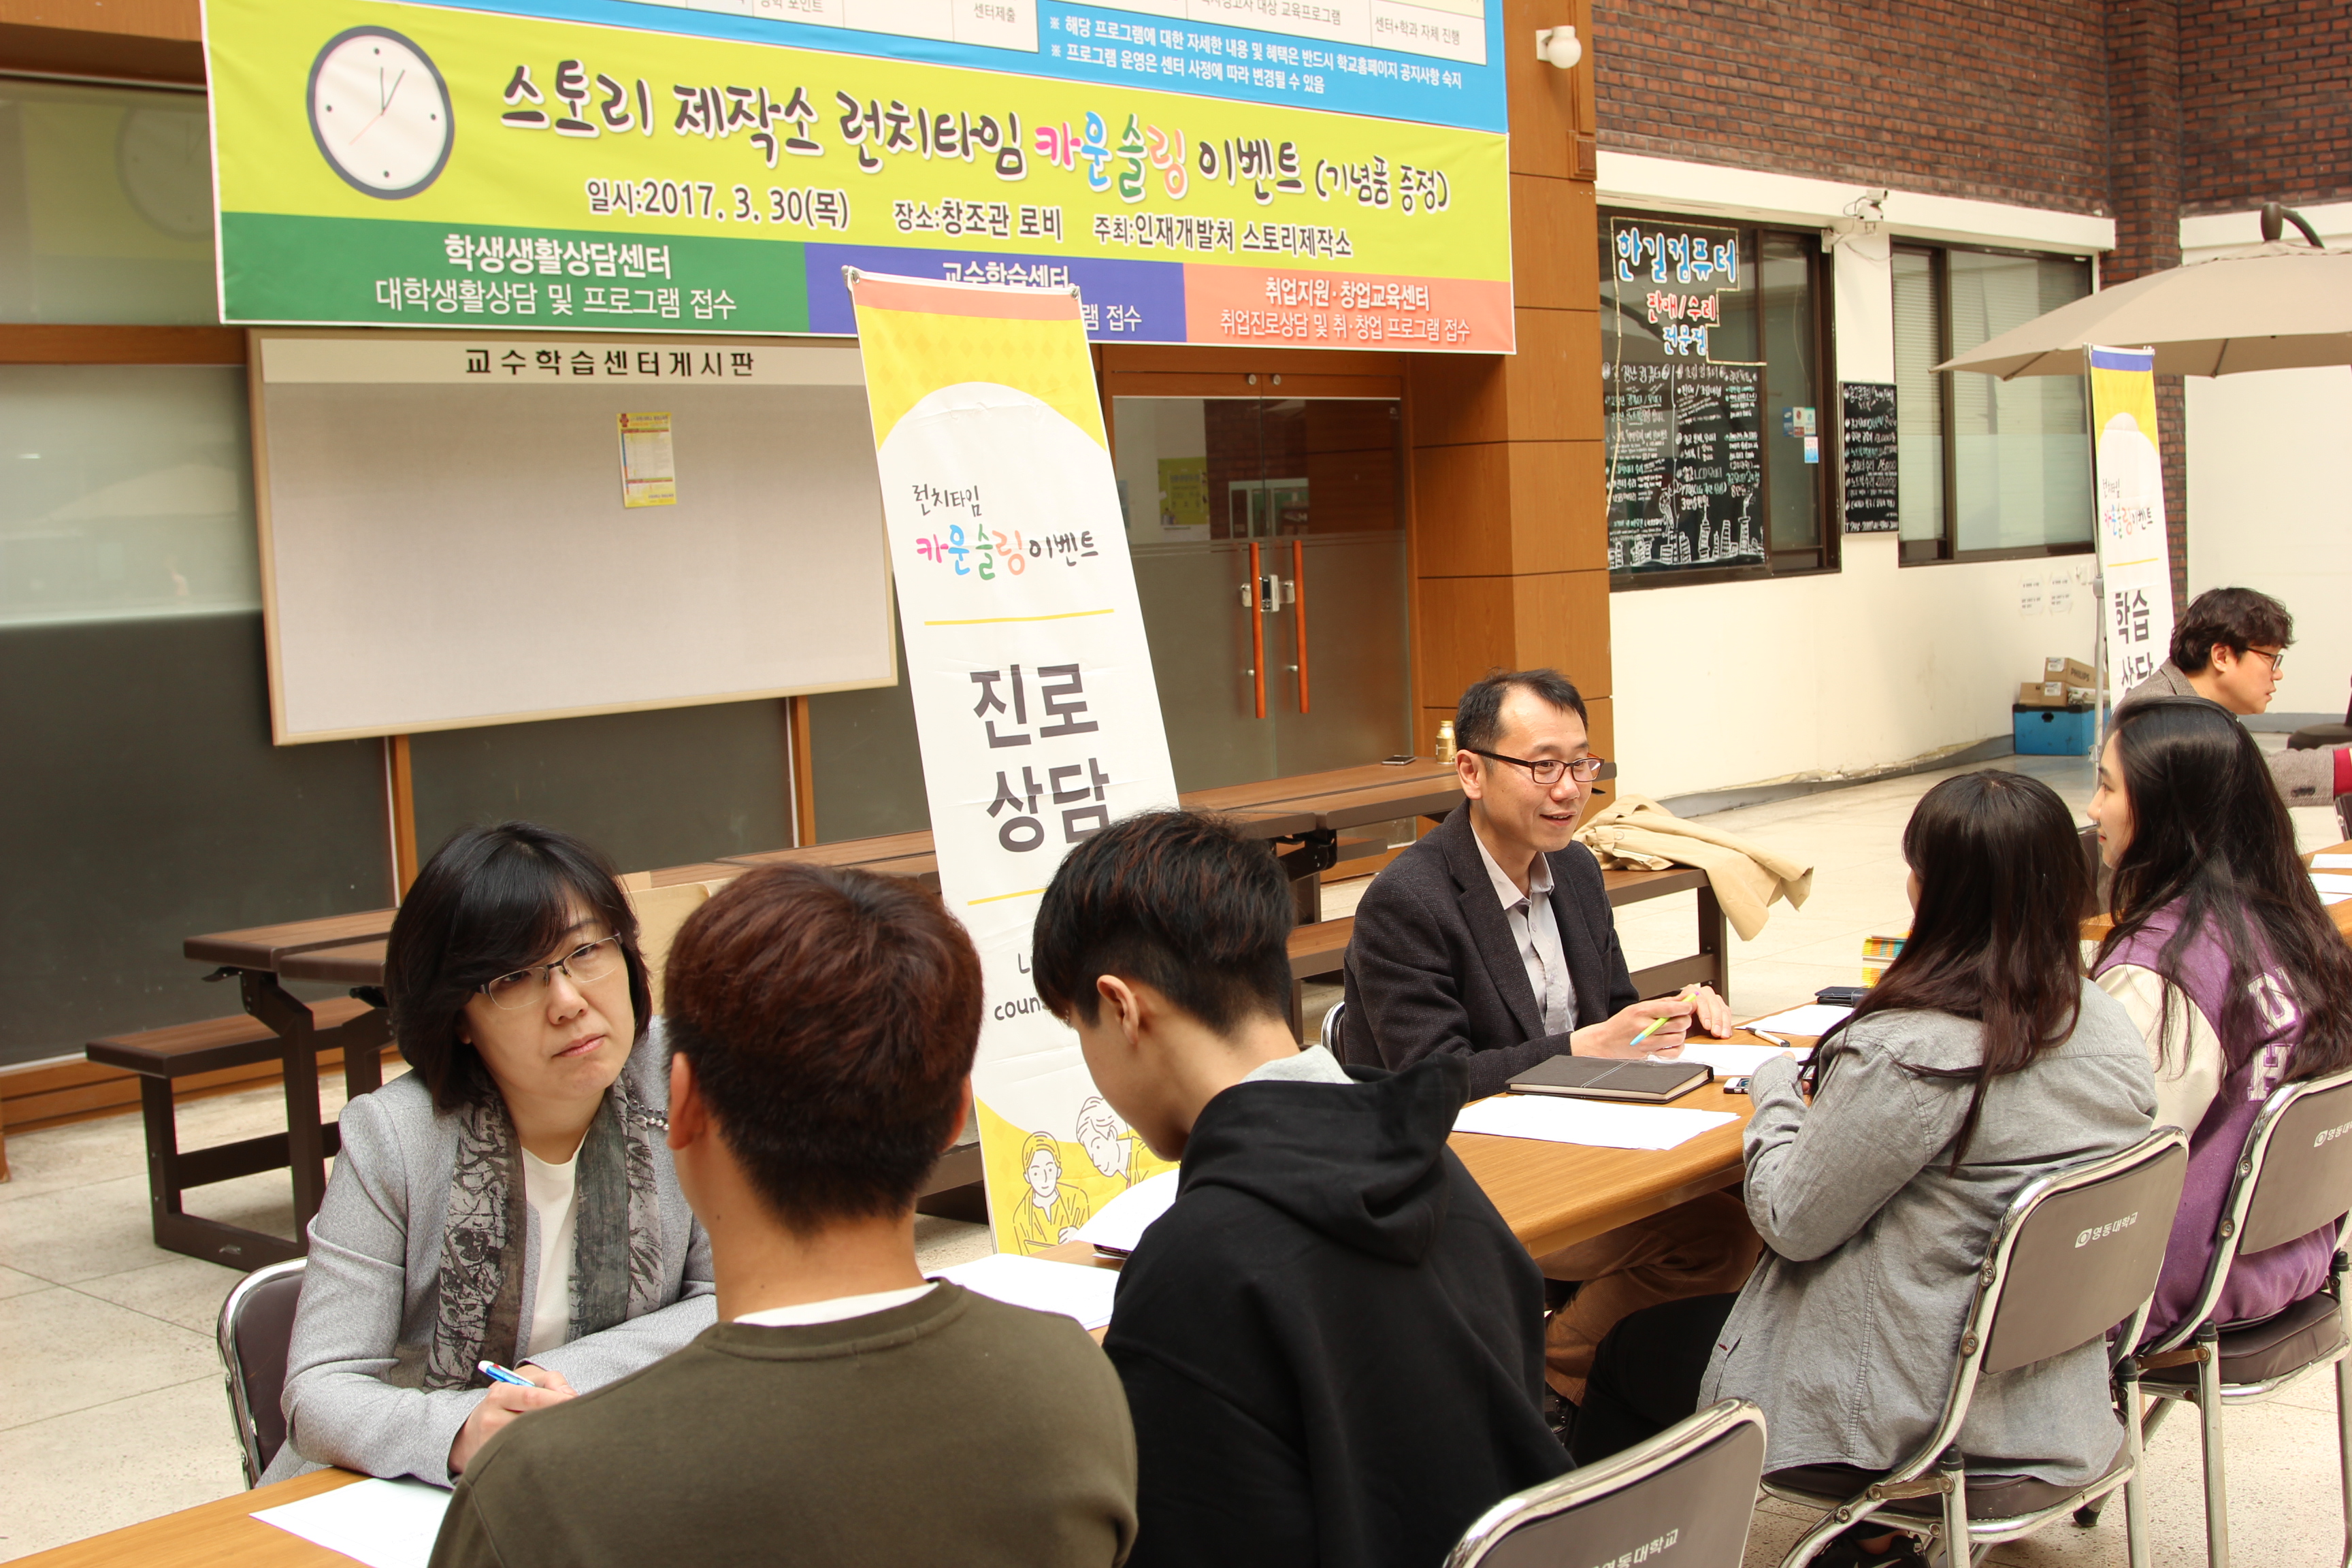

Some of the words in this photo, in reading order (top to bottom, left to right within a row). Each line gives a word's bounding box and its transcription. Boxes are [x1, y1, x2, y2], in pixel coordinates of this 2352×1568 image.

[973, 3, 1016, 22] 센터제출
[1257, 0, 1277, 16] 대상
[1281, 2, 1341, 25] 교육프로그램
[1375, 16, 1418, 37] 센터+학과
[1421, 24, 1439, 42] 자체
[1442, 28, 1460, 46] 진행
[1065, 16, 1091, 37] 해당
[1094, 20, 1156, 46] 프로그램에
[1160, 29, 1183, 50] 대한
[1187, 33, 1222, 55] 자세한
[1226, 38, 1248, 59] 내용
[1252, 42, 1263, 61] 및
[1266, 44, 1298, 65] 혜택은
[1302, 50, 1334, 70] 반드시
[1337, 53, 1398, 80] 학교홈페이지
[1400, 63, 1440, 86] 공지사항
[1441, 69, 1462, 89] 숙지
[1066, 44, 1117, 68] 프로그램
[1120, 50, 1158, 73] 운영은
[1160, 55, 1185, 77] 센터
[1188, 59, 1223, 81] 사정에
[1227, 65, 1250, 84] 따라
[1253, 67, 1286, 89] 변경될
[1288, 74, 1301, 91] 수
[1303, 75, 1324, 94] 있음
[502, 59, 651, 135] 스토리
[674, 84, 821, 167] 제작소
[836, 91, 1026, 179] 런치타임
[1034, 112, 1186, 200] 카운슬링
[1199, 138, 1304, 203] 이벤트
[1316, 154, 1390, 206] (기념품
[1399, 163, 1449, 212] 증정)
[770, 189, 849, 229] 30(목)
[894, 199, 1010, 237] 장소:창조관
[1019, 207, 1062, 241] 로비
[1094, 214, 1234, 252] 주최:인재개발처
[1242, 223, 1352, 258] 스토리제작소
[444, 233, 671, 280] 학생생활상담센터
[1616, 227, 1736, 284] 한길컴퓨터
[376, 277, 538, 315] 대학생활상담
[548, 284, 573, 316] 및
[583, 287, 681, 318] 프로그램
[690, 289, 737, 321] 접수
[1647, 290, 1716, 324] 판매/수리
[1106, 304, 1142, 332] 접수
[1220, 309, 1308, 338] 취업진로상담
[1313, 313, 1328, 338] 및
[1388, 316, 1440, 342] 프로그램
[1445, 318, 1470, 342] 접수
[1663, 324, 1707, 356] 전문점
[465, 349, 754, 377] 교수학습센터게시판
[912, 483, 982, 517] 런치타임
[2115, 589, 2150, 644] 학습
[970, 663, 1098, 749] 진로
[986, 757, 1110, 853] 상담
[994, 996, 1048, 1021] coun
[2328, 1121, 2352, 1141] 영동대
[2092, 1211, 2138, 1241] 영동대학교
